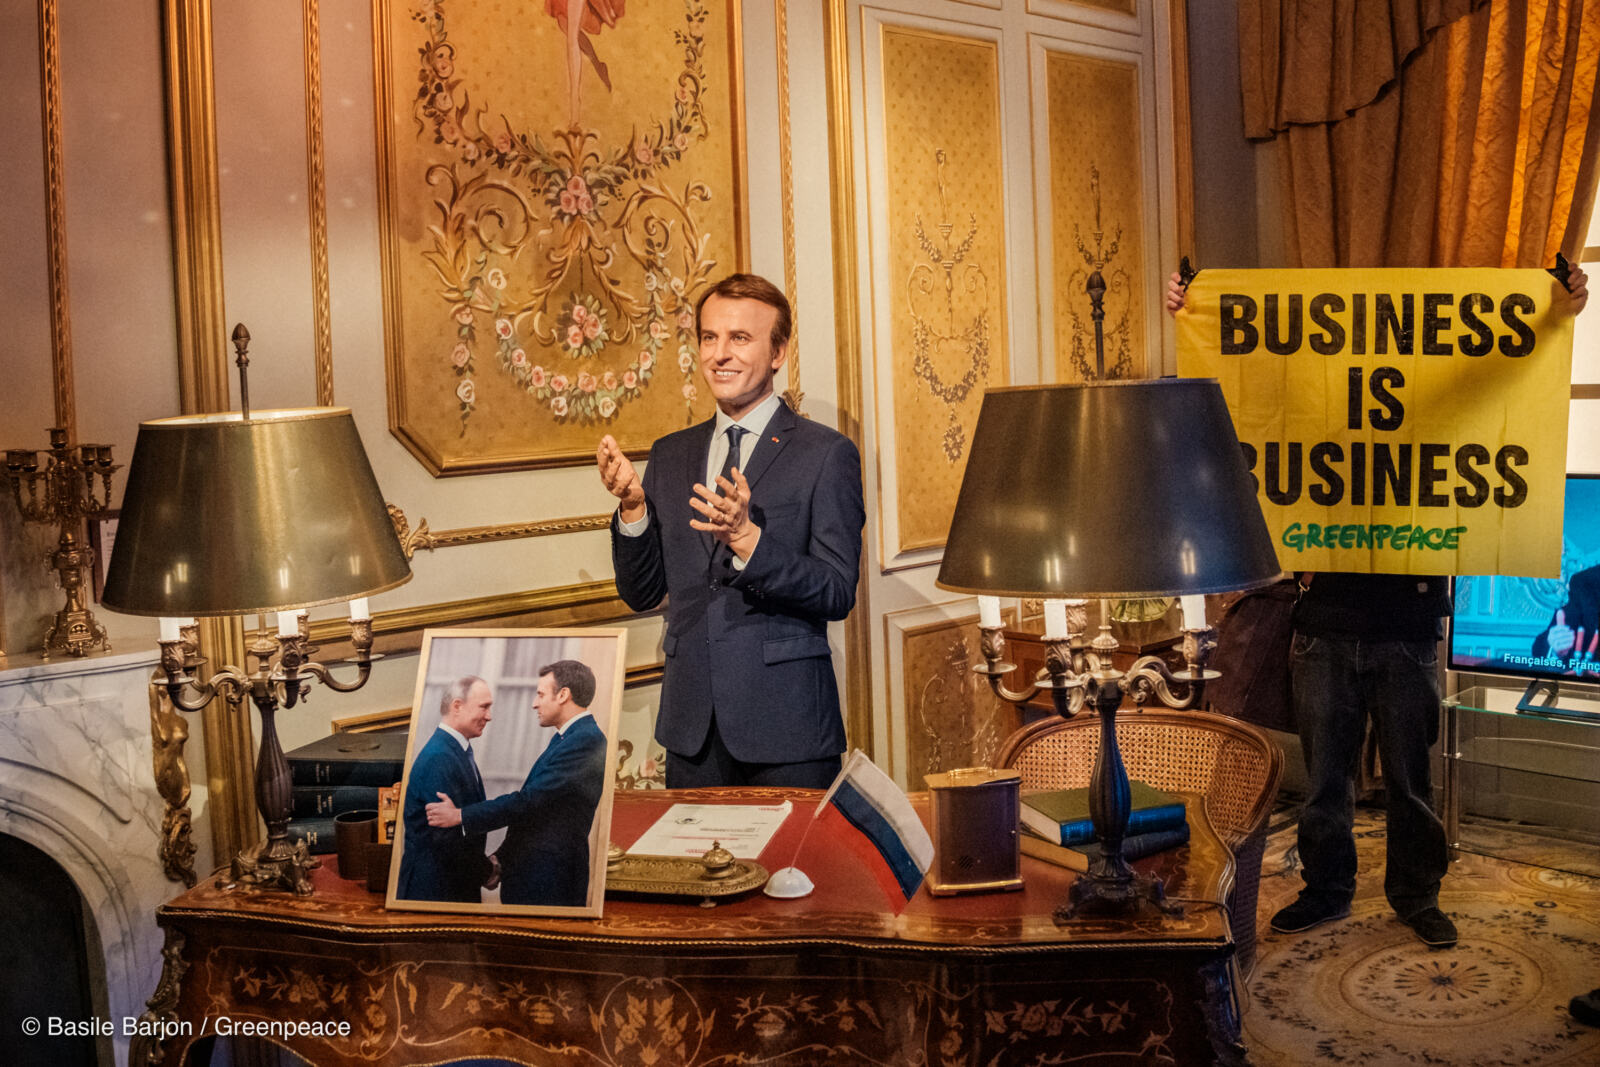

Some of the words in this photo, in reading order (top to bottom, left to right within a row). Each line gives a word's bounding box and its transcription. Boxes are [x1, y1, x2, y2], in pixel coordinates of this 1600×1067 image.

[1219, 292, 1536, 358] BUSINESS
[1347, 366, 1406, 432] IS
[1282, 522, 1468, 553] GREENPEACE
[1503, 653, 1566, 669] Françaises,
